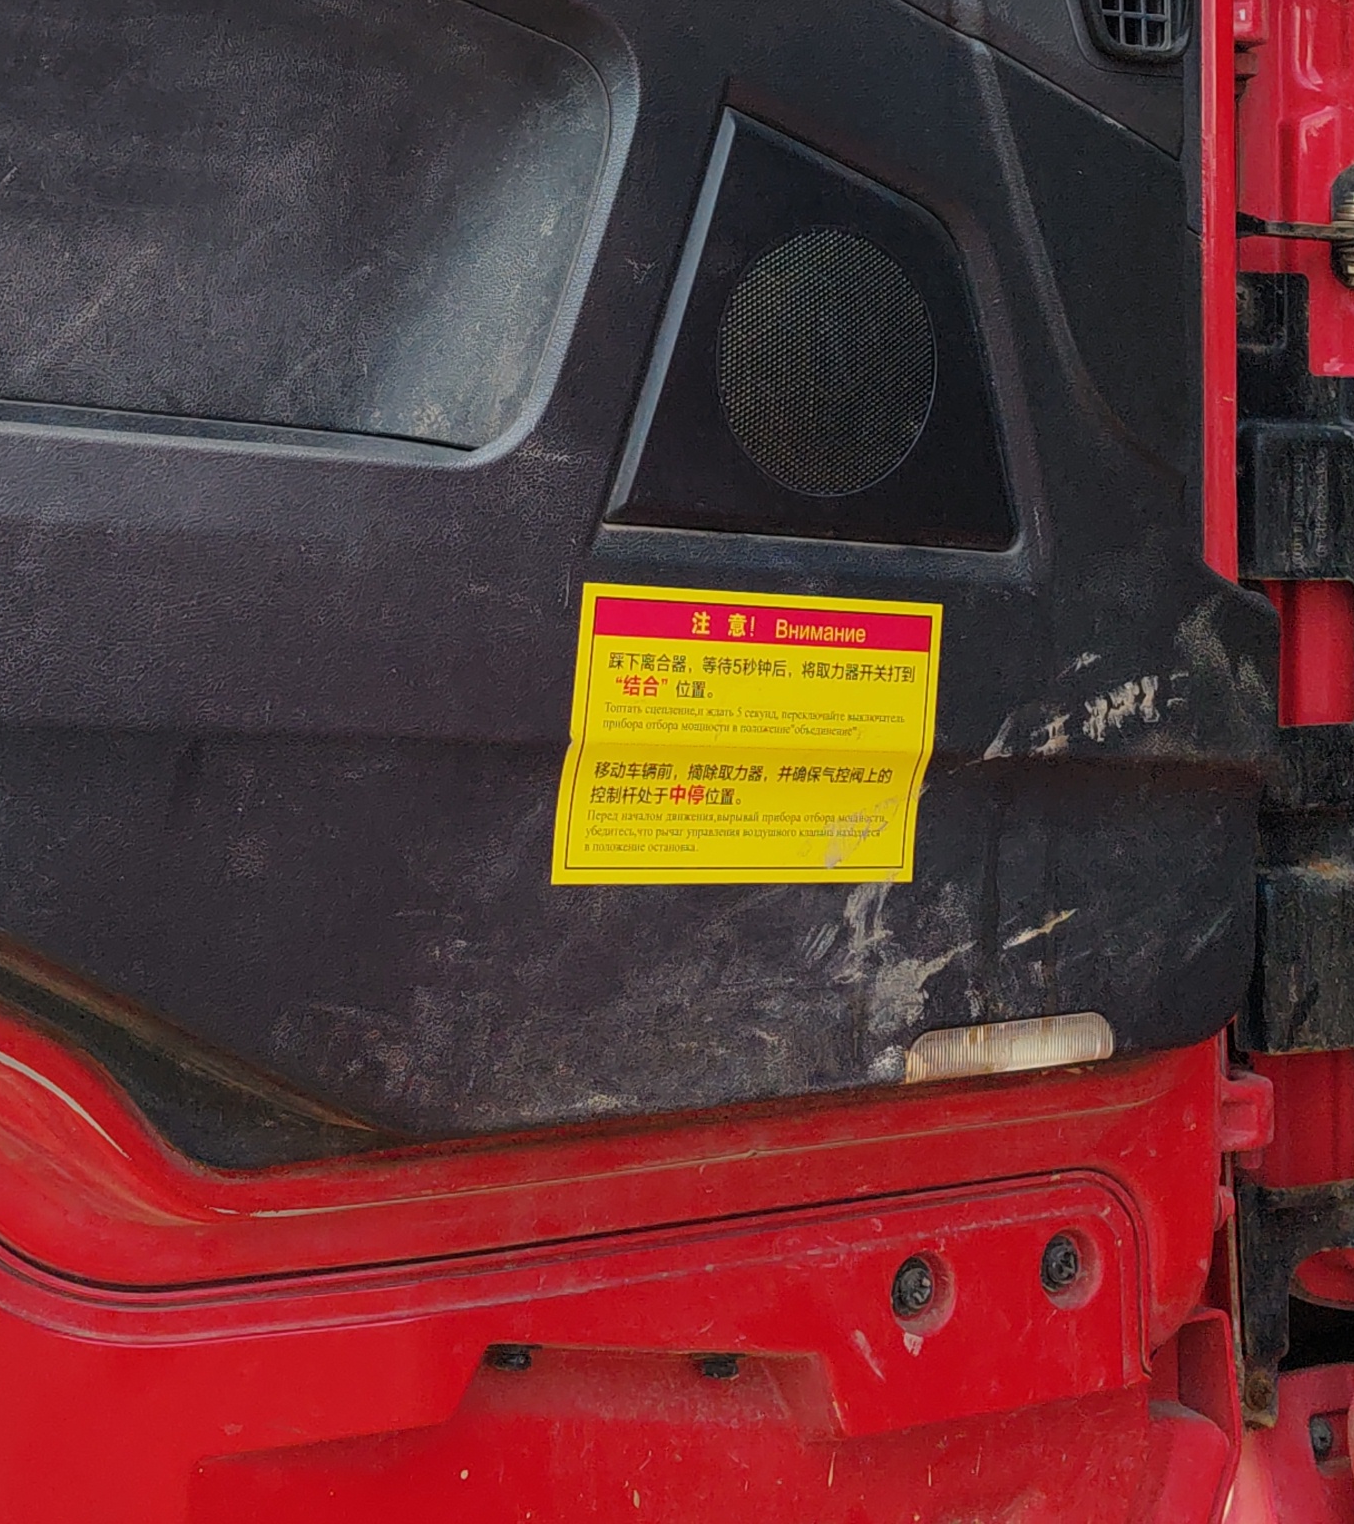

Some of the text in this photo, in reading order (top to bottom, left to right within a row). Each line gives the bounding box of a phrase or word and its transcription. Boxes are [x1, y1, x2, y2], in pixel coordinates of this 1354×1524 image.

[775, 619, 867, 643] Внимание
[605, 702, 643, 714] Топтать
[707, 708, 734, 717] ждать
[736, 707, 742, 716] 5
[603, 718, 643, 732] прибора
[646, 719, 678, 732] отбора
[681, 722, 729, 733] мощности
[732, 724, 738, 732] в
[587, 810, 618, 822] Перед
[621, 812, 662, 821] началом
[762, 811, 801, 824] прибора
[804, 811, 835, 824] отбора
[655, 828, 683, 838] рычаг
[686, 828, 740, 839] управления
[743, 828, 796, 839] воздушного
[593, 843, 645, 852] положение
